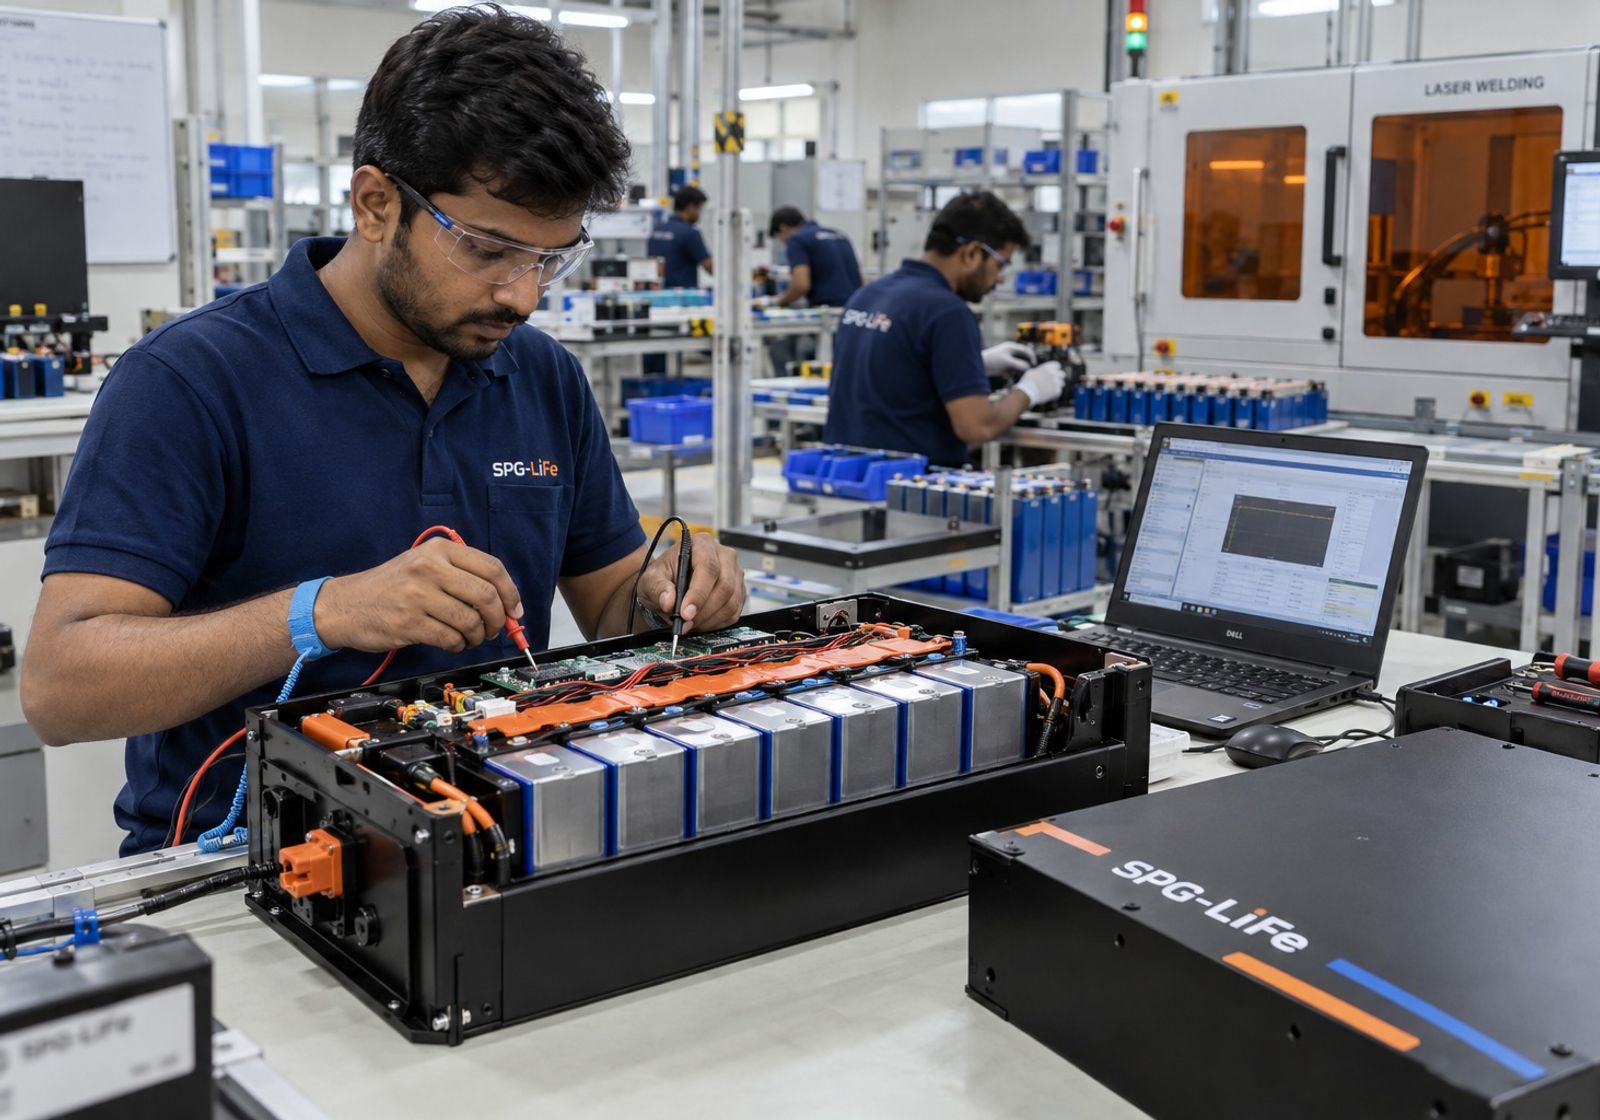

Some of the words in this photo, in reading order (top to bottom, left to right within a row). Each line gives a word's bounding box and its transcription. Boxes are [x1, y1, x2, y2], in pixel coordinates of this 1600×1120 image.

[1424, 81, 1471, 97] LASER
[1475, 76, 1545, 93] WELDING
[492, 459, 559, 477] SPG-LiFe
[1226, 629, 1243, 640] DELL
[1111, 860, 1309, 953] SPG-LiFe
